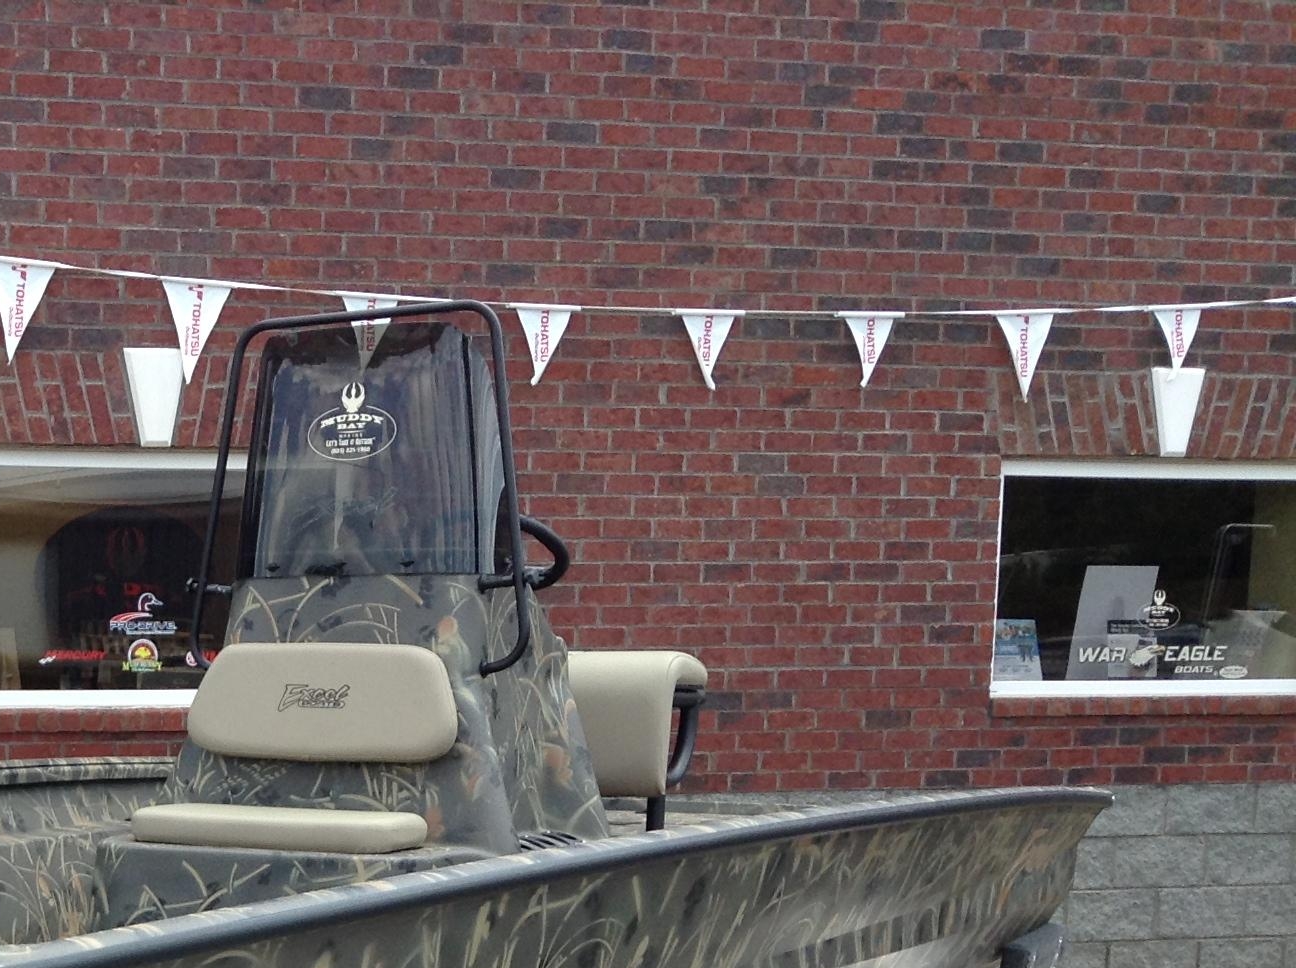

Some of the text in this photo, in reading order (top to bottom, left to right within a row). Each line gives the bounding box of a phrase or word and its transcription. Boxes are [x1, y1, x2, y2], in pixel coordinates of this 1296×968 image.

[14, 282, 26, 338] TOHATSU
[190, 302, 202, 357] TOHATSU
[540, 310, 550, 363] TOHATSU
[1019, 326, 1029, 378] TOHATSU
[320, 413, 384, 429] MUDDY
[337, 422, 366, 430] BAY
[1078, 645, 1228, 663] WAR EAGLE
[1174, 665, 1214, 674] BOATS
[278, 684, 351, 712] Excel
